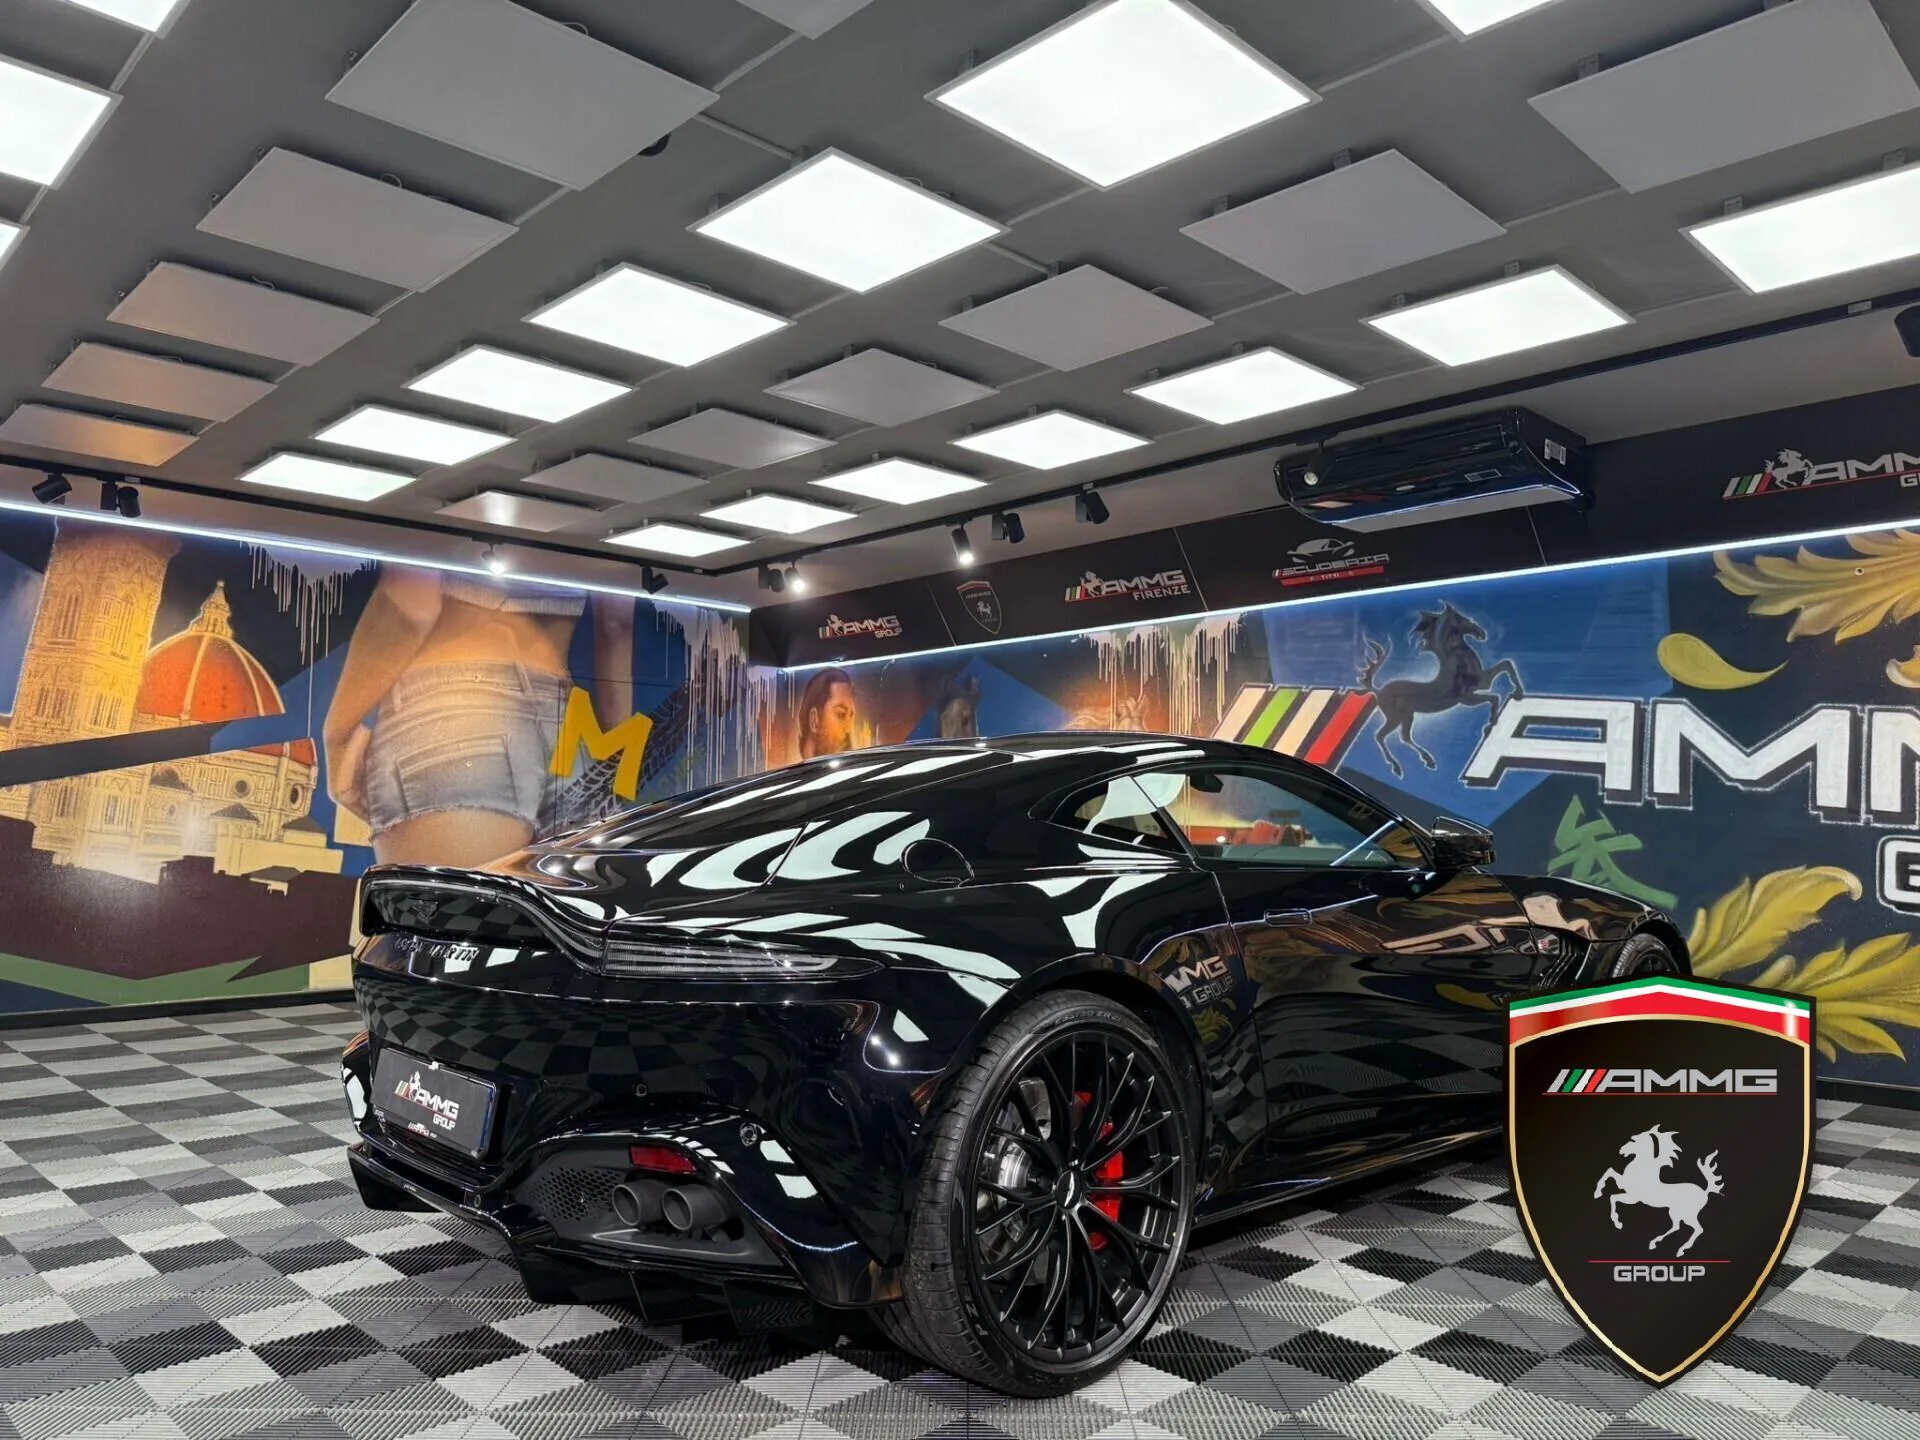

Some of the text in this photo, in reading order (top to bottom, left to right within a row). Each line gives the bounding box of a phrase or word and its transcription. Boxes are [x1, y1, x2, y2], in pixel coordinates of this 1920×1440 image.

[1100, 569, 1187, 596] AMMG
[1133, 584, 1192, 601] FIRENZE
[843, 615, 900, 635] AMMG
[414, 1088, 460, 1120] AMMG
[432, 1113, 456, 1131] GROUP
